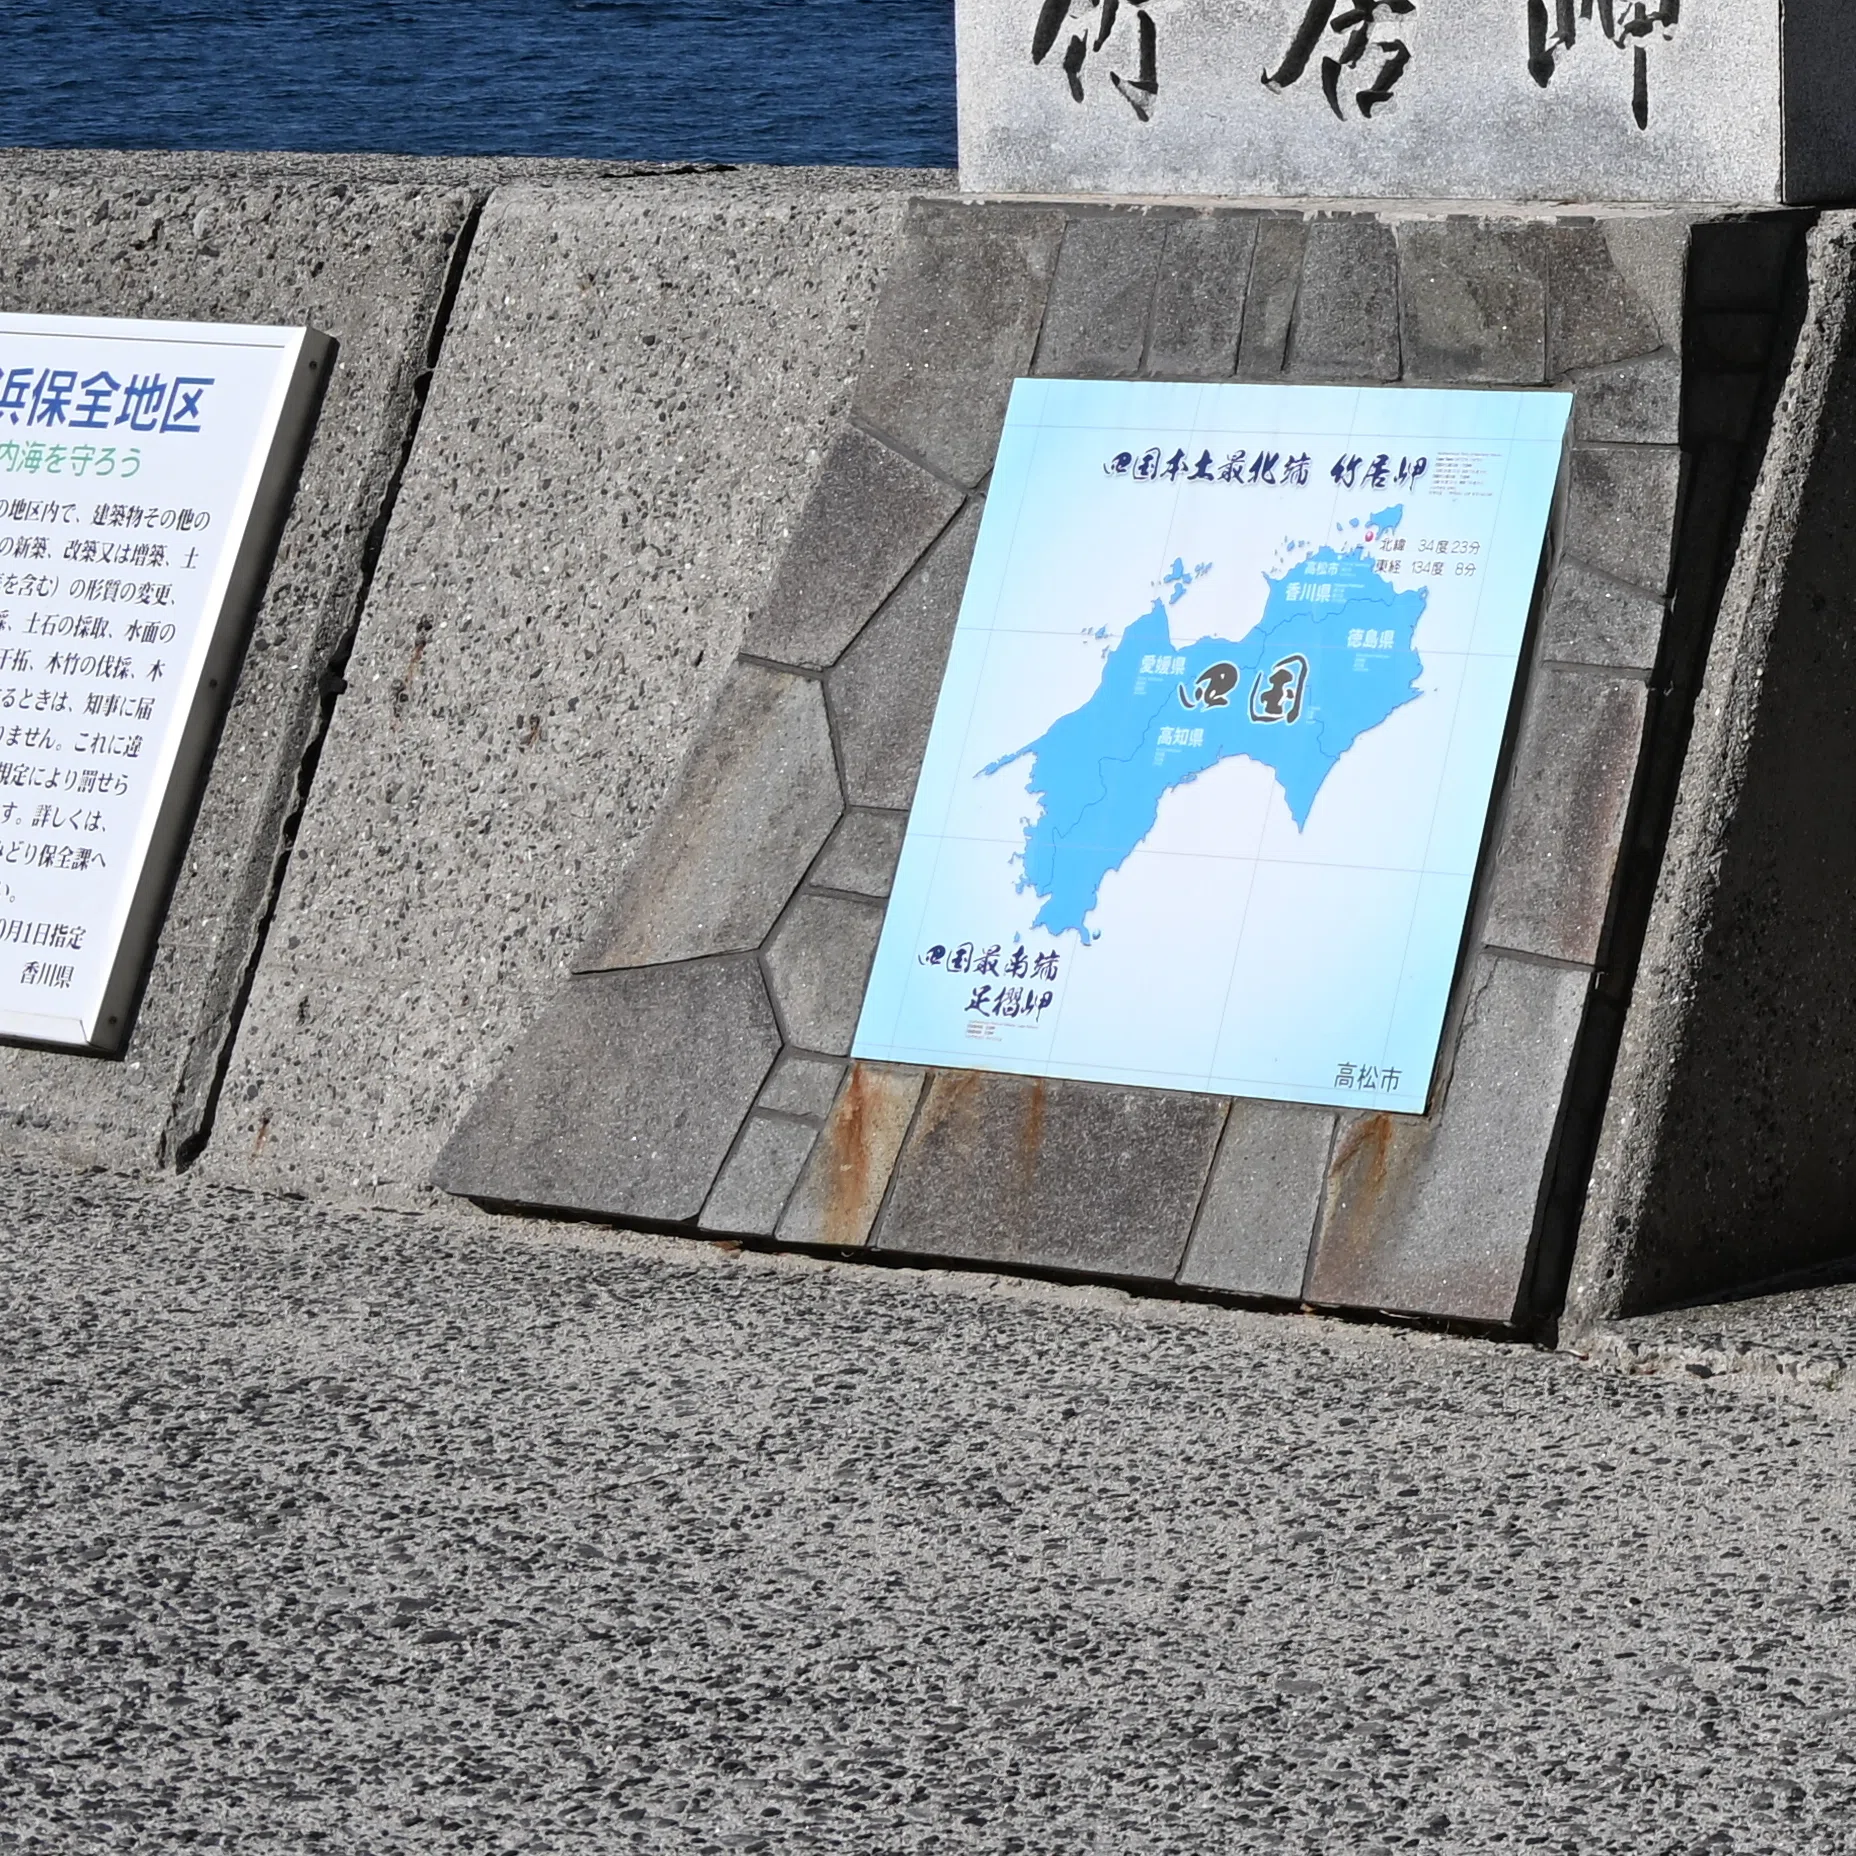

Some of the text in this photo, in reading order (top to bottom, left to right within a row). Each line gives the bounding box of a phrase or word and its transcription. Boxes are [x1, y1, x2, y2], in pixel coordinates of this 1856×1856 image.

[0, 439, 141, 478] 内海を守ろう
[1103, 446, 1312, 486] 四国本土最北端
[1329, 452, 1428, 492] 竹居岬
[1304, 561, 1340, 577] 高松市
[0, 573, 175, 606] を含む）の形質の変更、
[1285, 582, 1332, 603] 香川県
[1347, 628, 1396, 650] 徳島県
[1139, 654, 1187, 676] 愛媛県
[1178, 652, 1310, 724] 四国
[0, 688, 156, 721] るときは、知事に届
[1157, 726, 1205, 748] 高知県
[20, 960, 74, 989] 香川県
[918, 941, 1061, 982] 四国最南端
[964, 984, 1054, 1023] 足摺岬
[1334, 1061, 1403, 1093] 高松市
